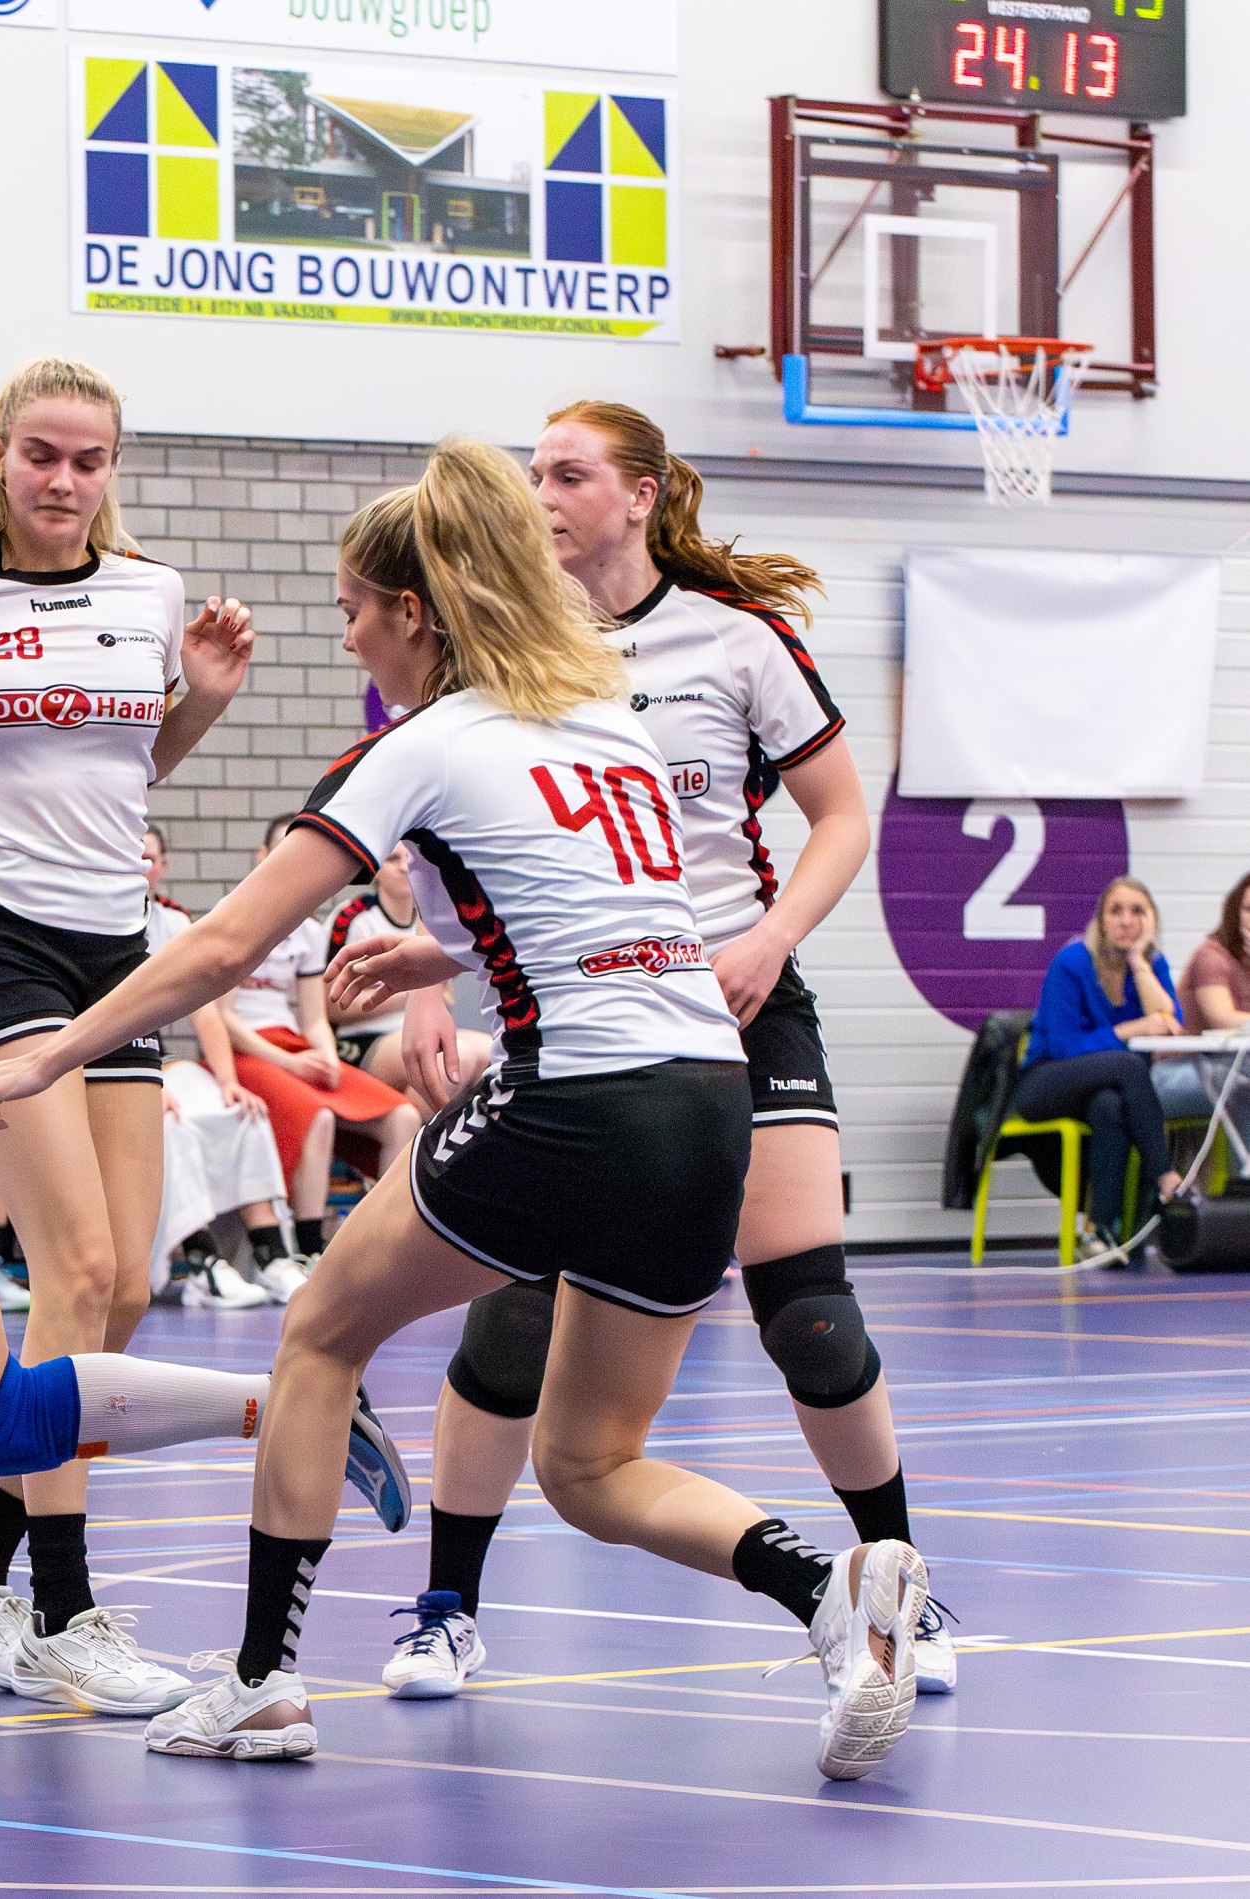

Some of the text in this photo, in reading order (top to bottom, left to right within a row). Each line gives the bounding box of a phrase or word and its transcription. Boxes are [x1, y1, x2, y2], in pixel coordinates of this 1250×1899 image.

[86, 243, 670, 314] DE JONG BOUWONTWERP
[30, 594, 92, 613] hummel
[650, 692, 704, 705] HV HAARLE
[530, 763, 682, 885] 40
[962, 798, 1046, 940] 2
[770, 1077, 817, 1092] hummel
